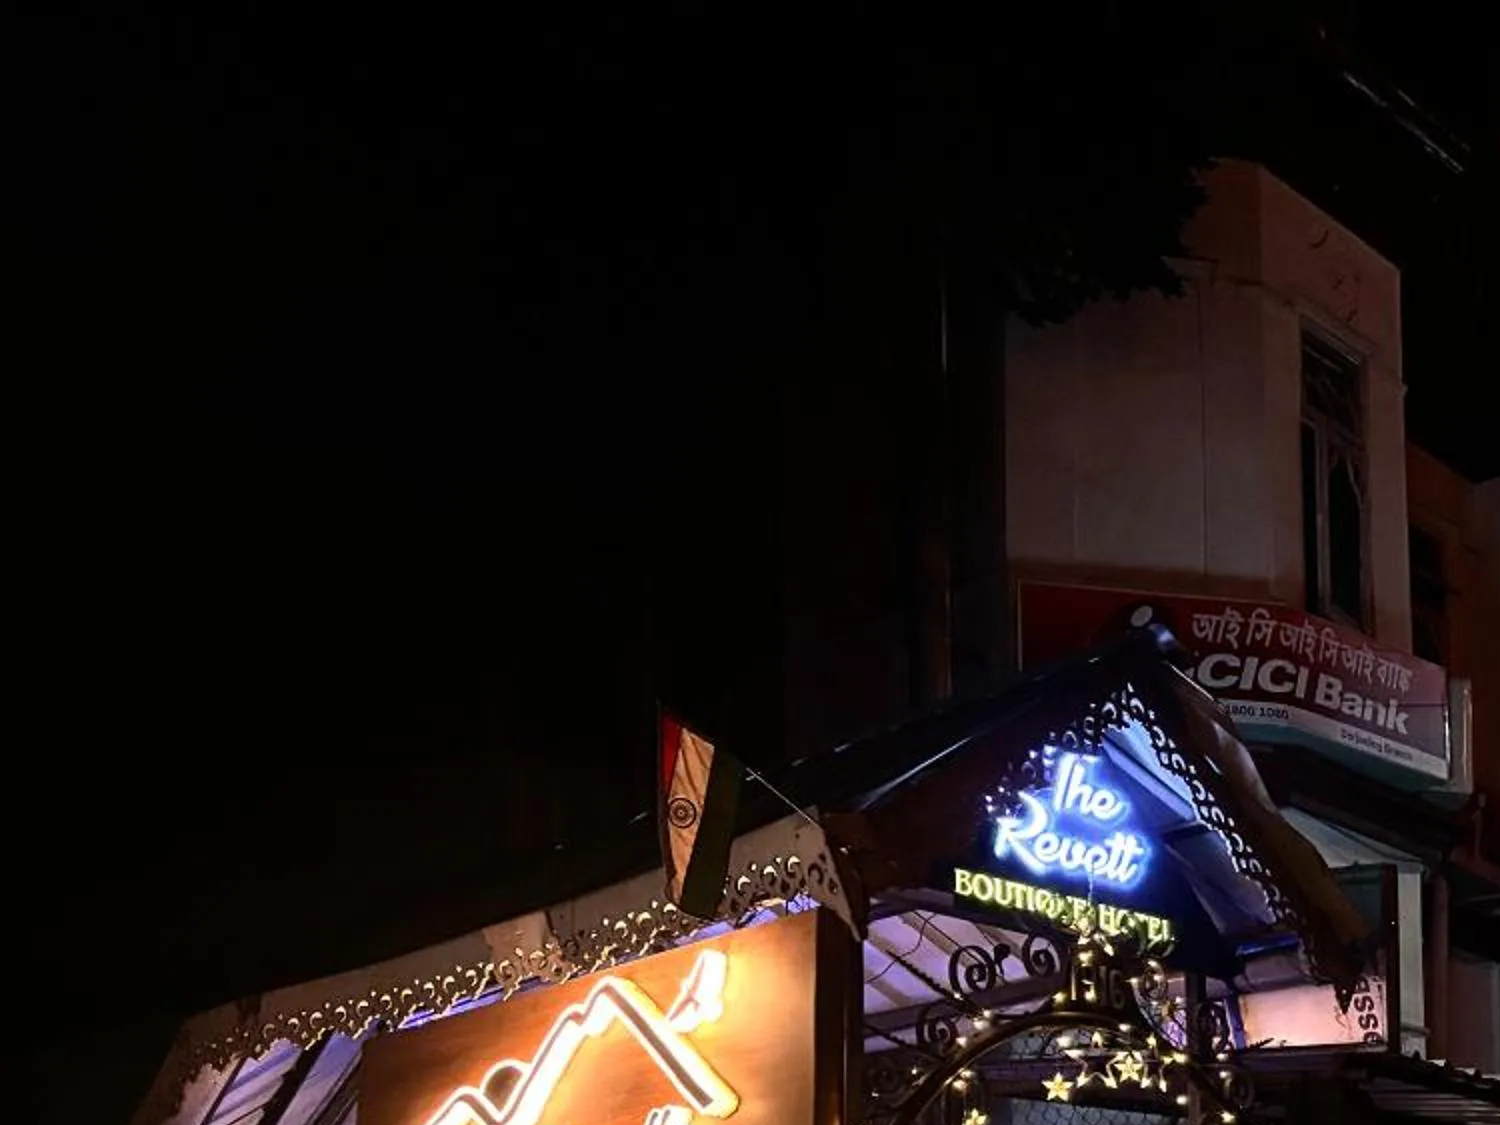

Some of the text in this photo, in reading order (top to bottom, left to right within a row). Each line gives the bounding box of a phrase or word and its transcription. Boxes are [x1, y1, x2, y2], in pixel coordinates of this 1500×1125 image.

[1186, 652, 1410, 735] CICI Bank
[1053, 752, 1124, 820] The
